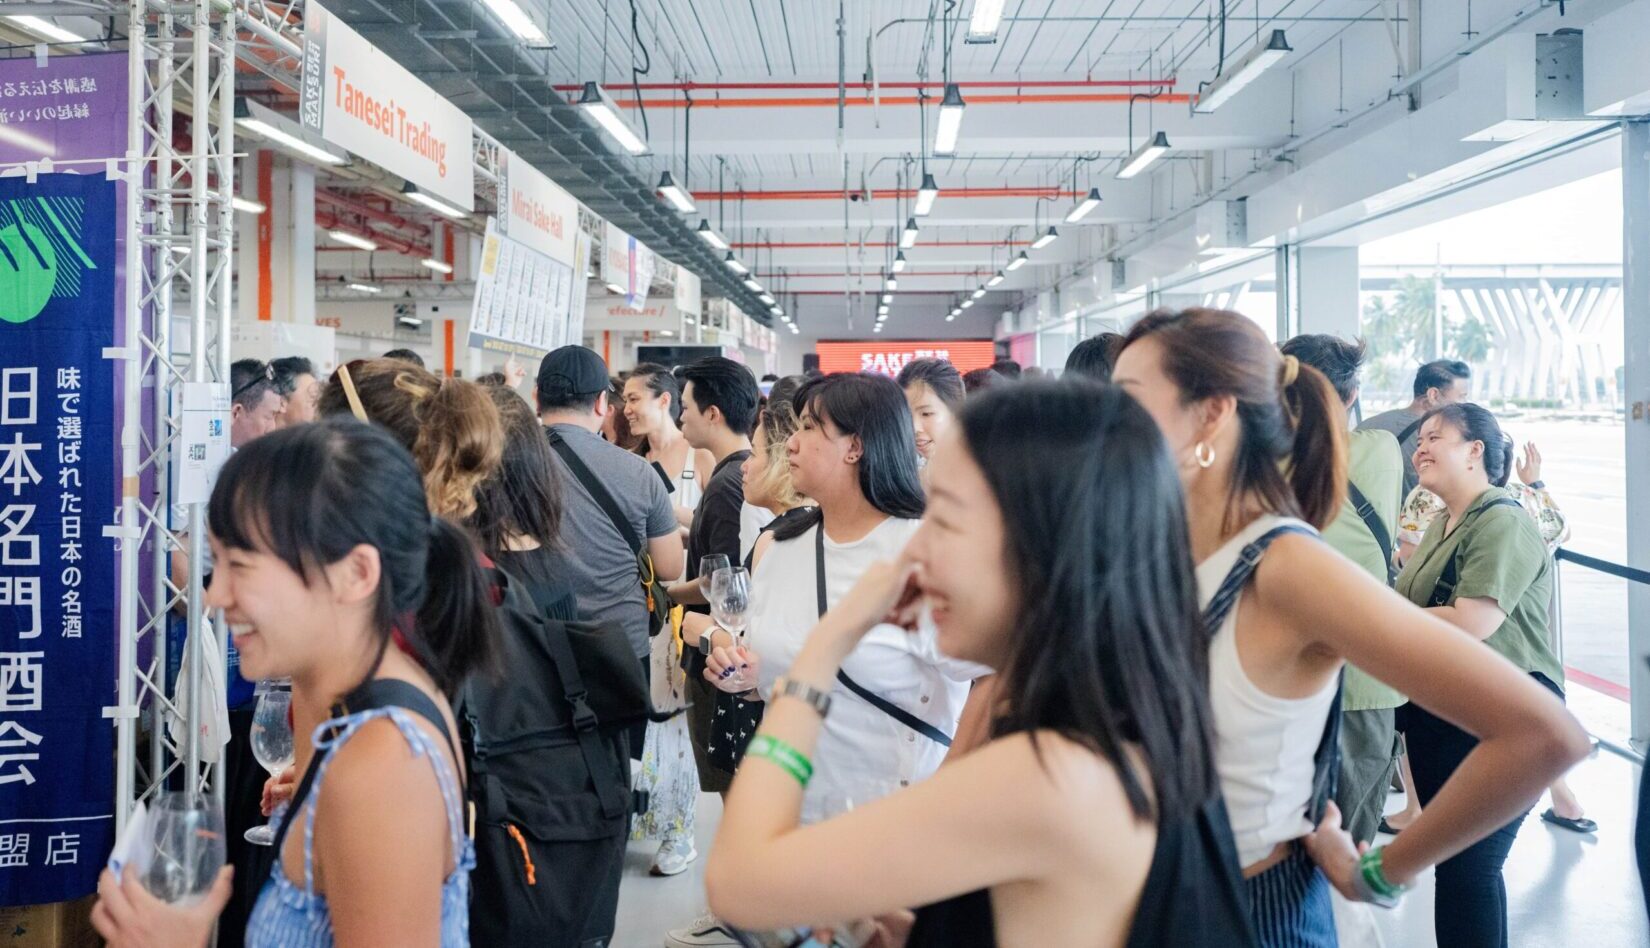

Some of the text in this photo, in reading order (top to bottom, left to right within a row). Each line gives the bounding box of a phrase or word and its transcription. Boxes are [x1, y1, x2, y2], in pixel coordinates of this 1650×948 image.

[310, 41, 320, 128] MATSURI
[333, 65, 446, 178] Tanesei Trading
[861, 352, 913, 366] SAKE
[57, 367, 82, 639] 味で選ばれた日本の名酒
